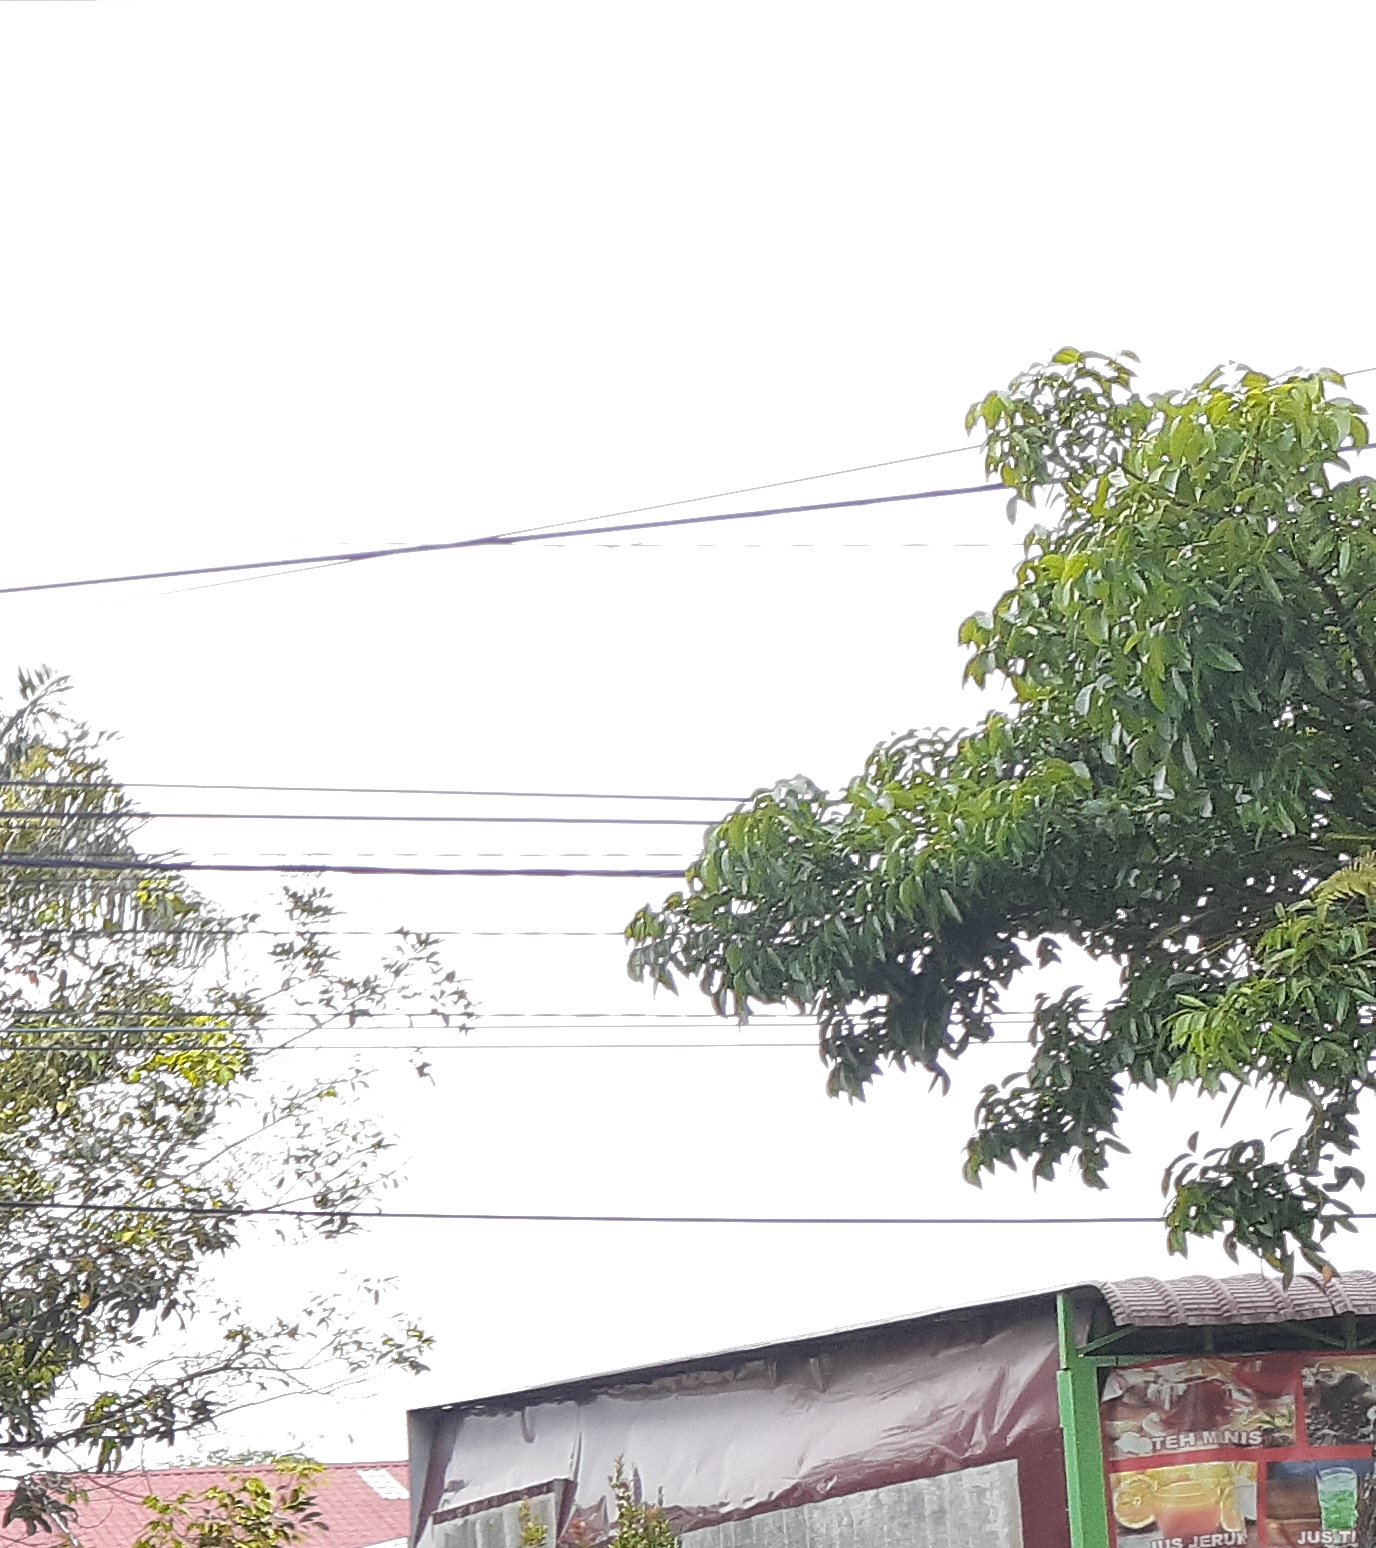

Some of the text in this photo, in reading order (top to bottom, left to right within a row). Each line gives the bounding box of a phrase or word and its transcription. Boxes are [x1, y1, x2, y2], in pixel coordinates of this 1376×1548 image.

[1151, 1432, 1195, 1450] TEH
[1188, 1531, 1248, 1548] JERUK
[1297, 1530, 1333, 1545] JUS
